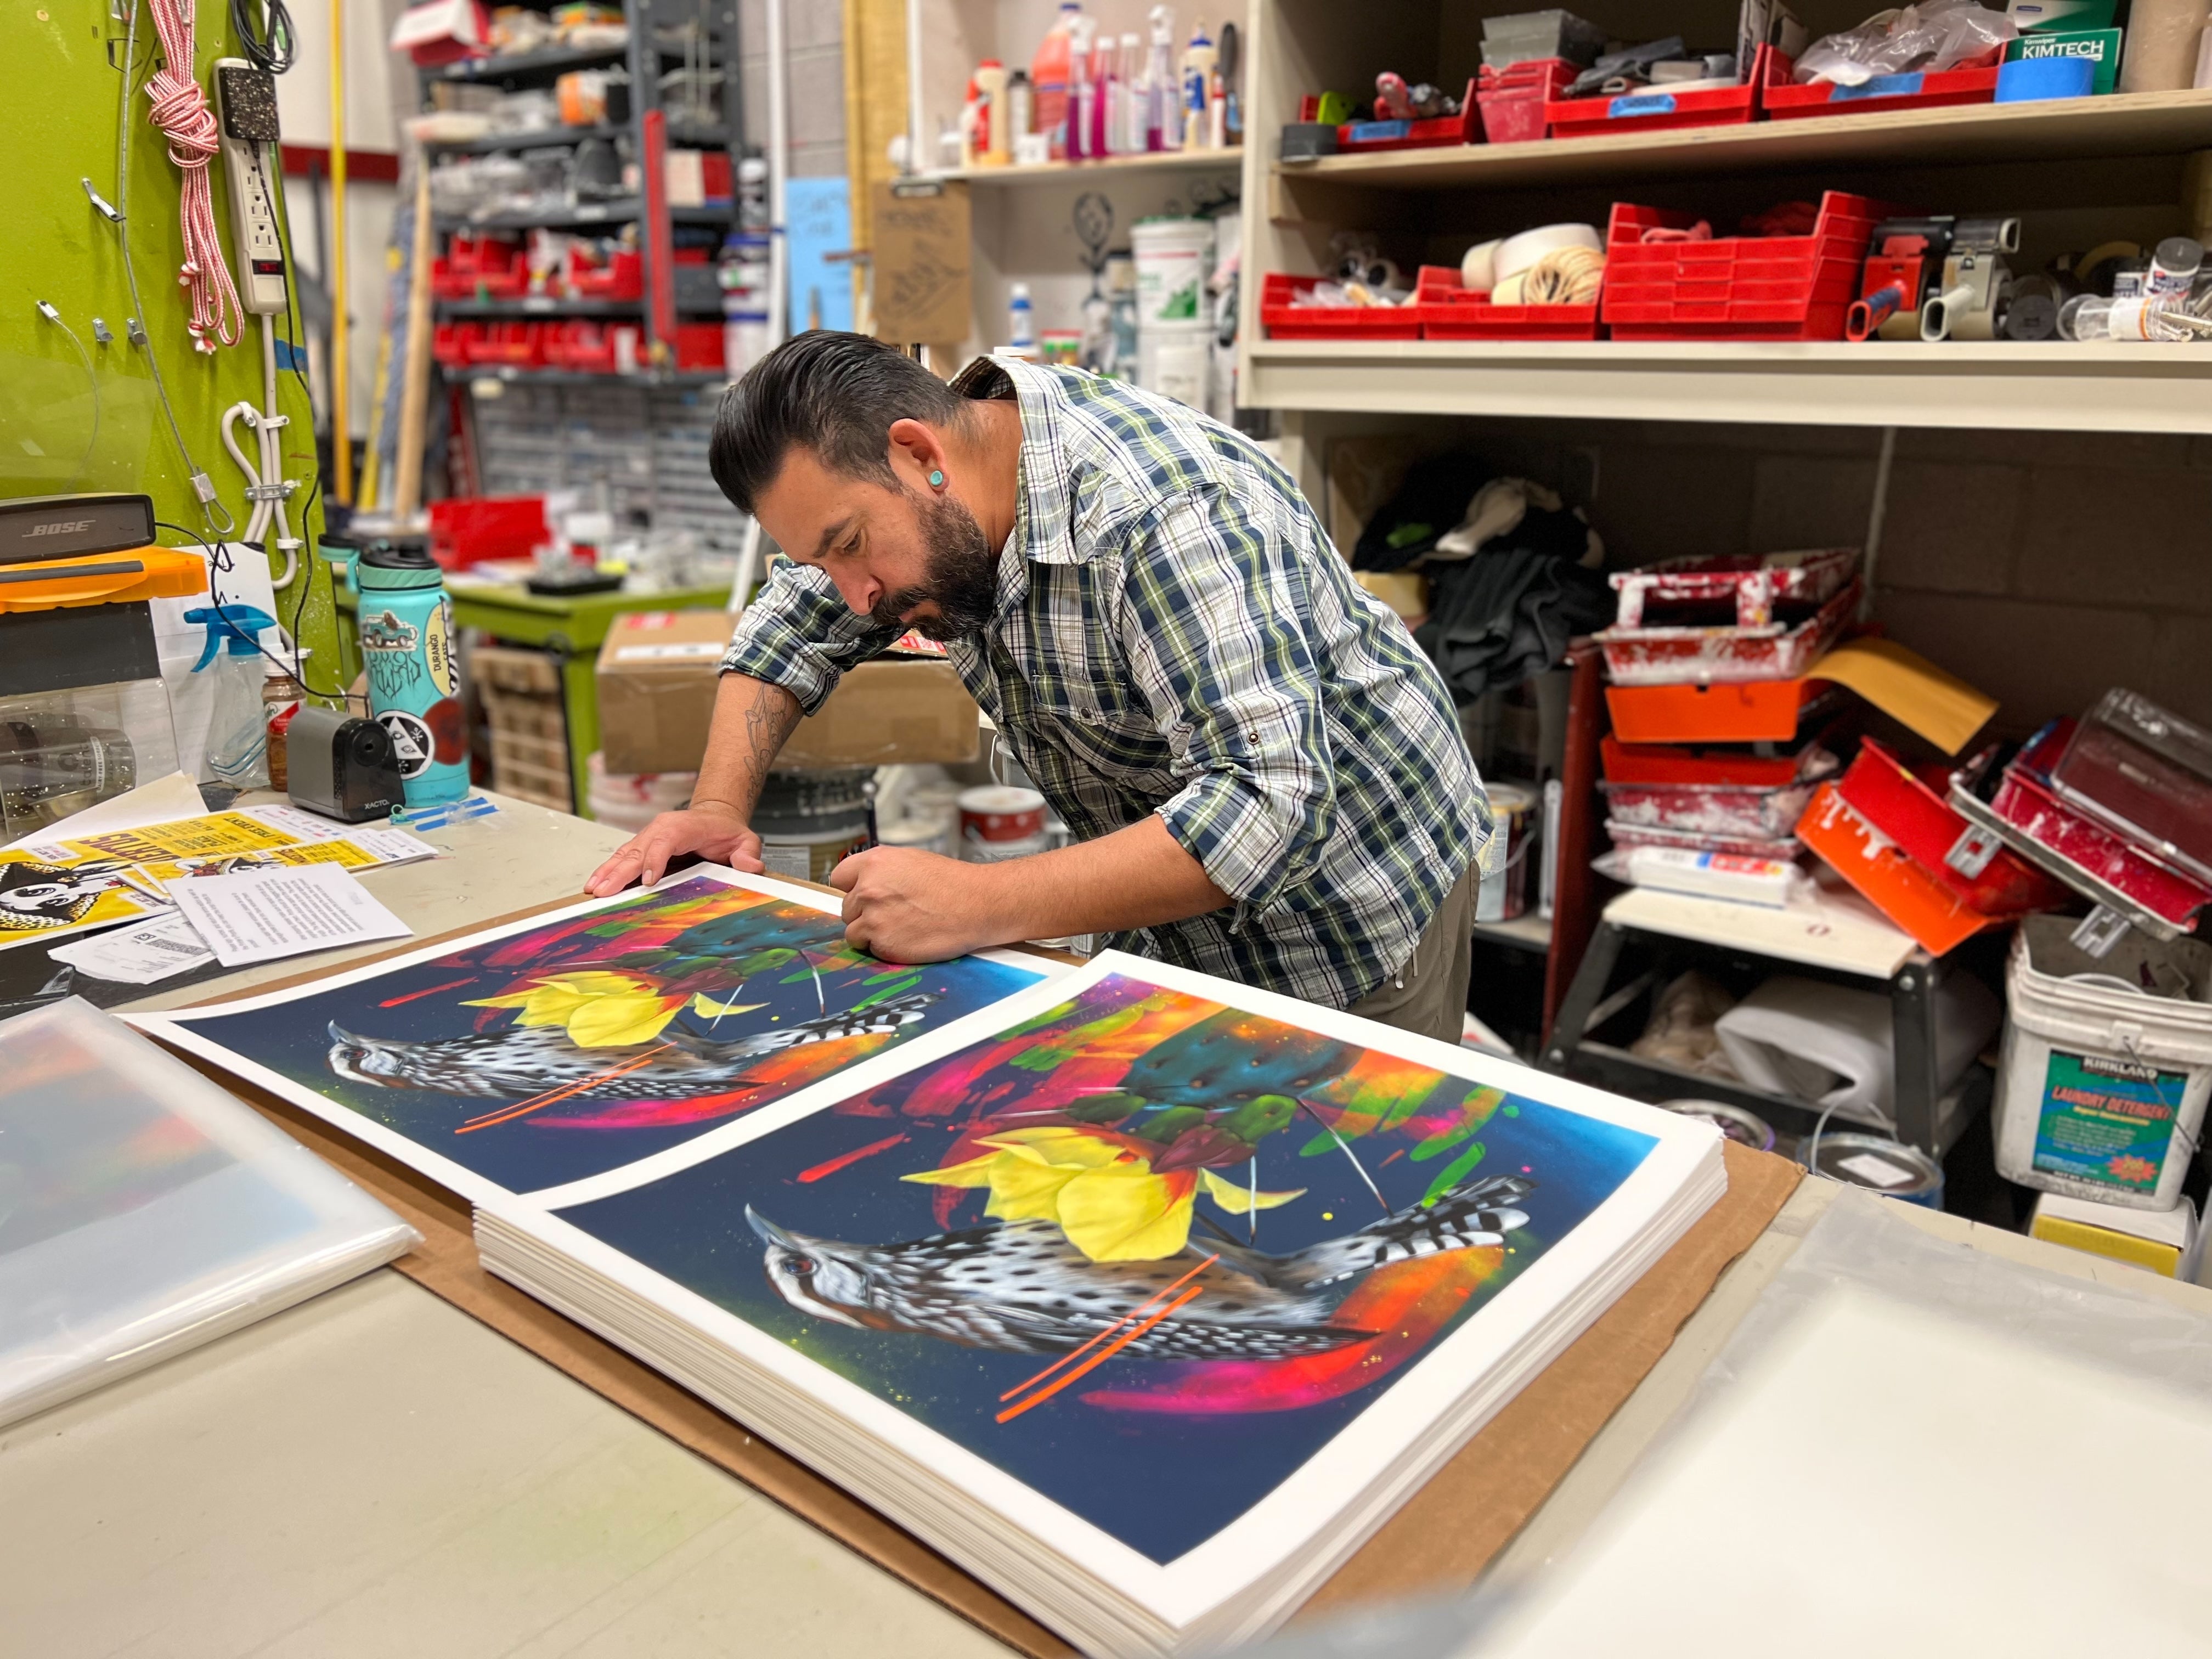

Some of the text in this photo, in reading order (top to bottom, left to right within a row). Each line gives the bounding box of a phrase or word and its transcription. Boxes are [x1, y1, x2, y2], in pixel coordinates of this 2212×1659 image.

[2022, 40, 2104, 59] KIMTECH
[22, 520, 96, 537] BOSE
[430, 634, 442, 672] DURANGO
[77, 833, 182, 862] UERTOS
[2083, 1057, 2158, 1080] KIRKLAND
[2051, 1085, 2107, 1109] LAUNDRY
[2106, 1097, 2172, 1120] DETERGENT
